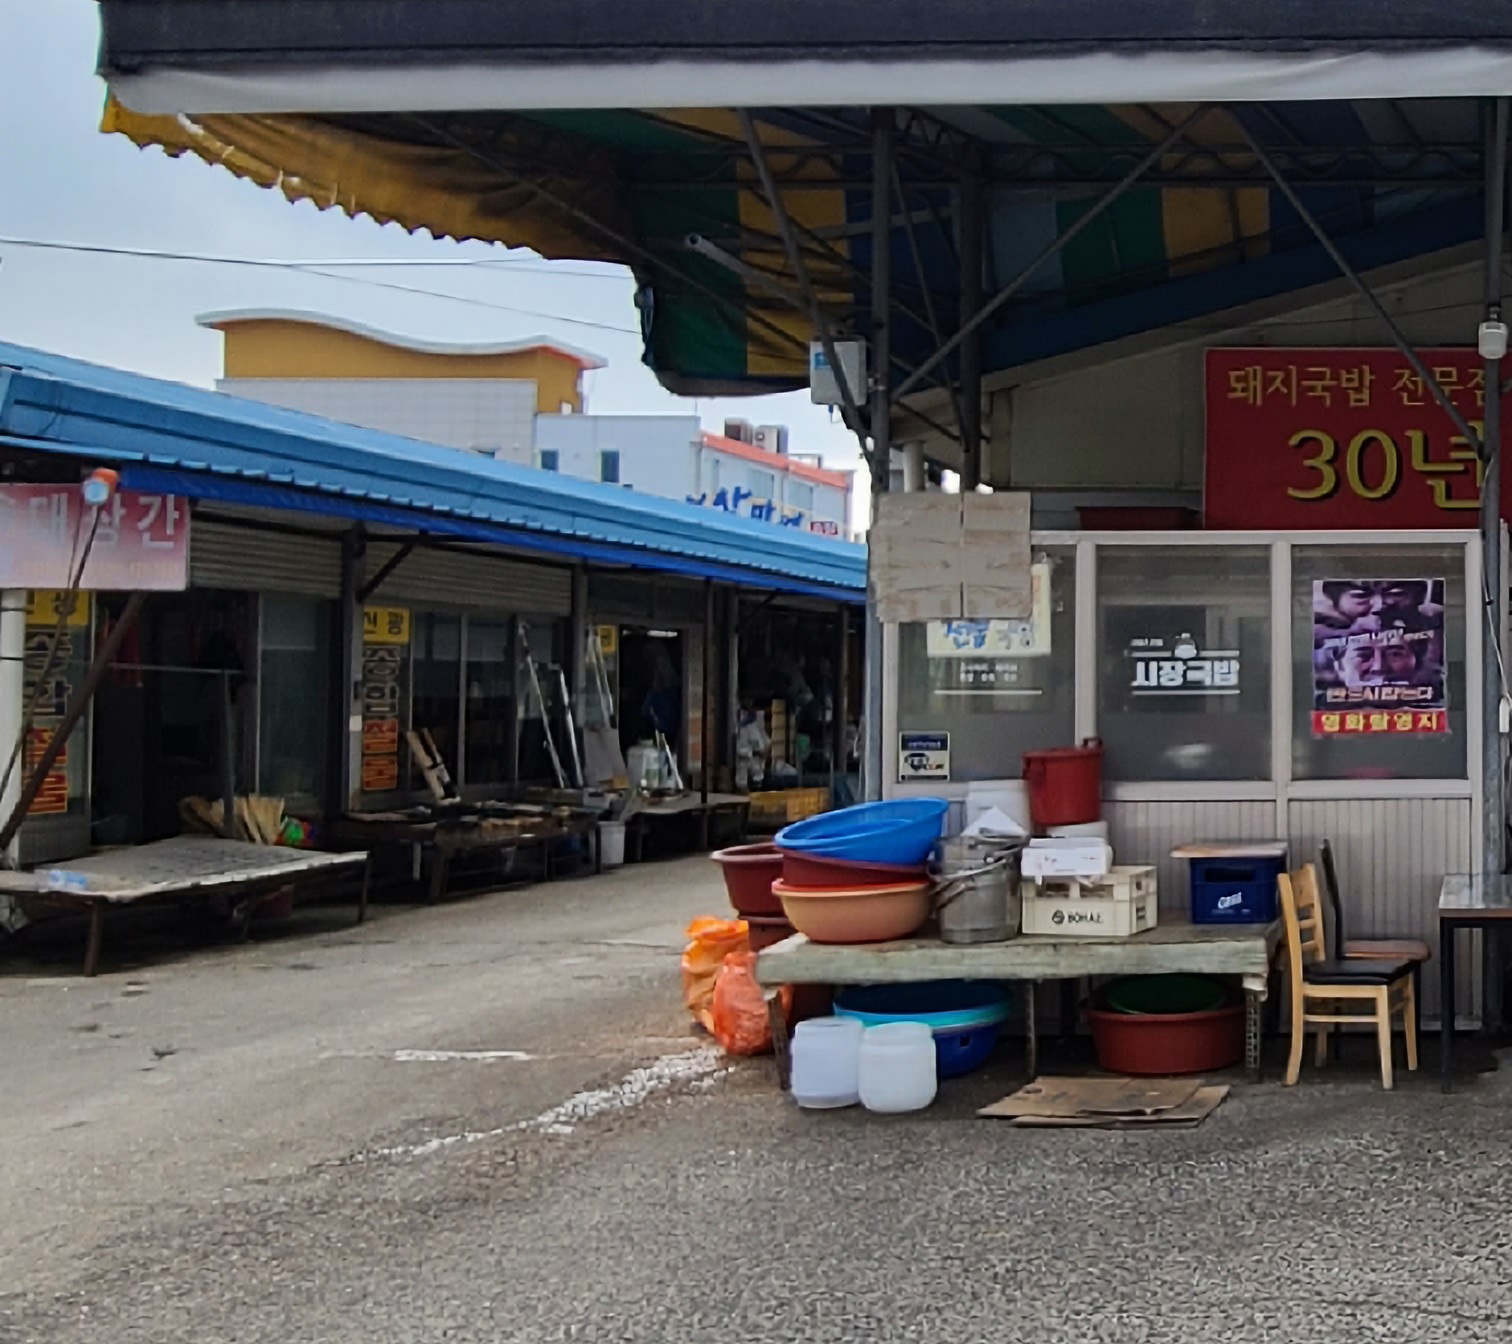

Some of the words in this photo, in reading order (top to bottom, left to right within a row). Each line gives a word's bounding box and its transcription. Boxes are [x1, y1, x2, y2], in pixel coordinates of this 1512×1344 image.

[1227, 366, 1375, 406] 돼지국밥
[1286, 421, 1484, 511] 30년
[1131, 660, 1240, 686] 시장국밥
